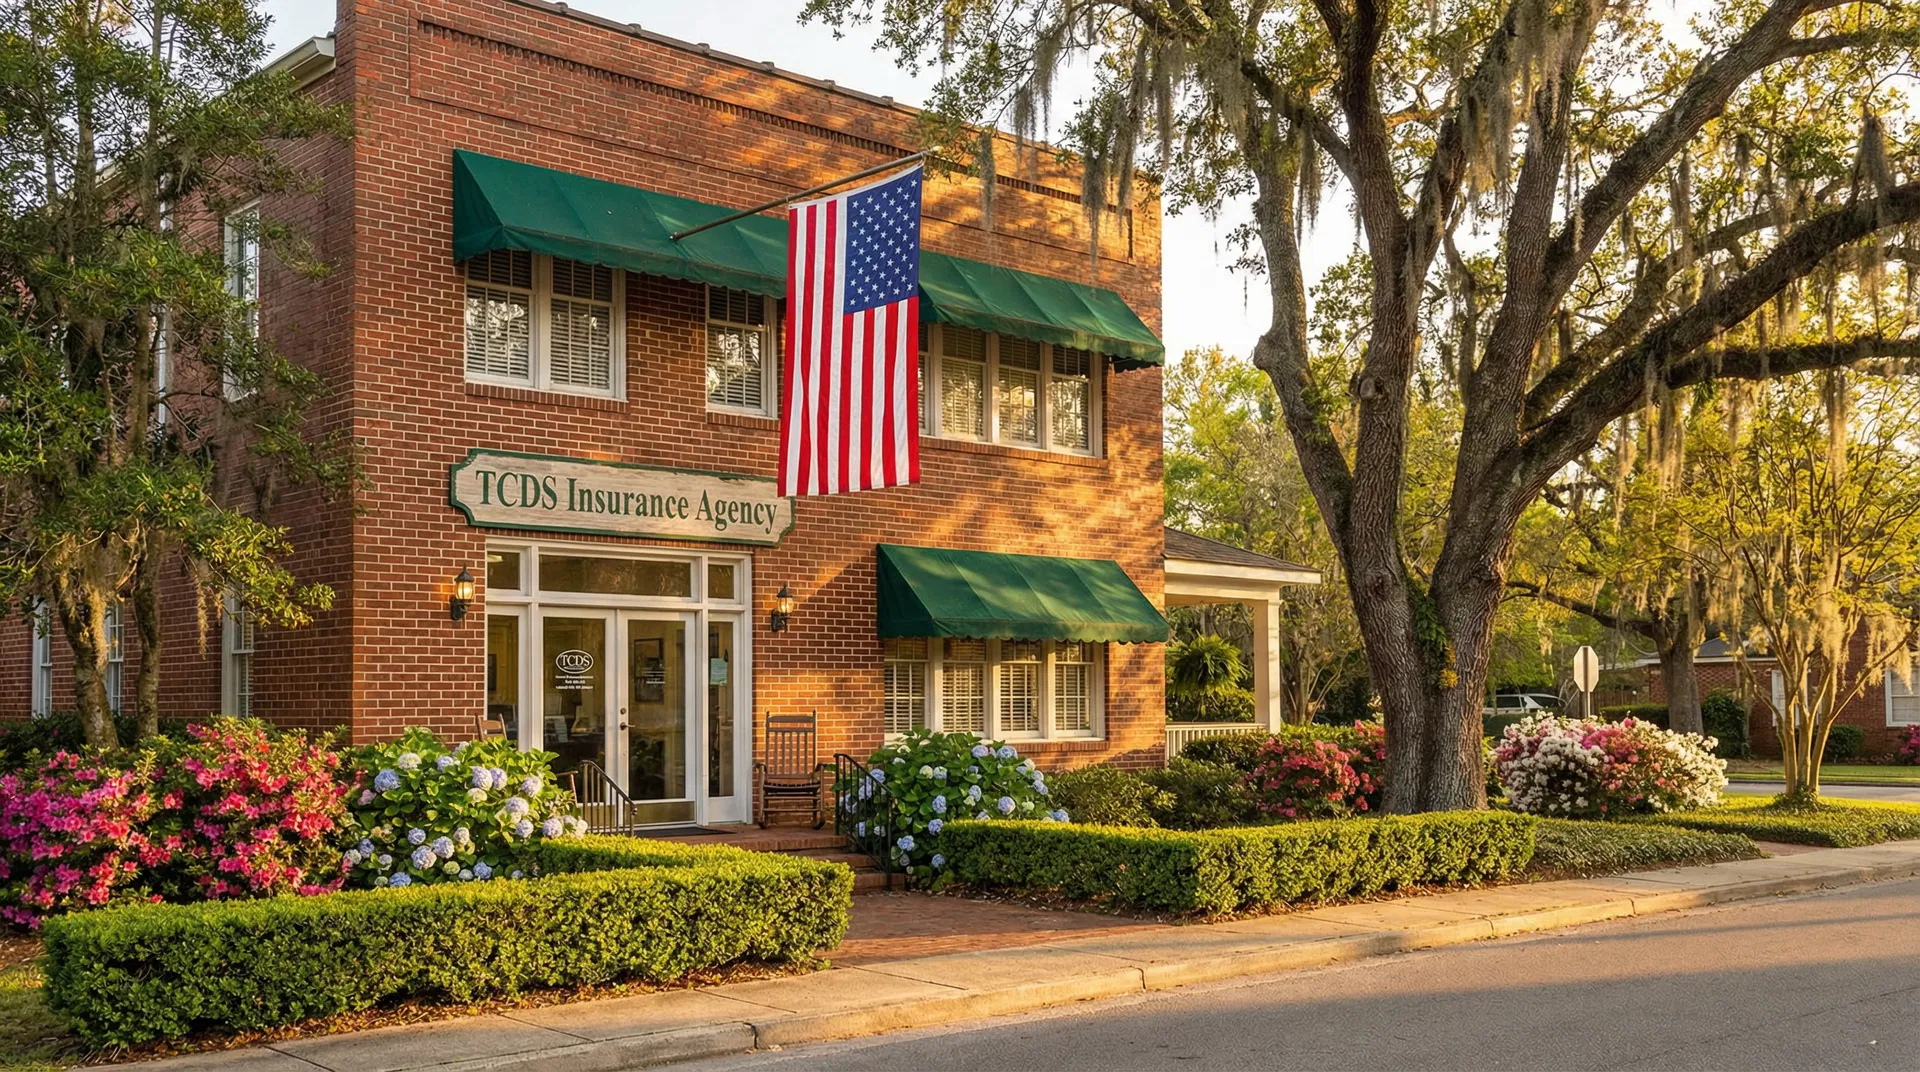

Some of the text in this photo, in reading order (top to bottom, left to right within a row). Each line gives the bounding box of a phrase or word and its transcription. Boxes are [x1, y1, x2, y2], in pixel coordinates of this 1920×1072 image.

[475, 470, 778, 534] TCDS Insurance Agency
[560, 654, 590, 666] TCDS
